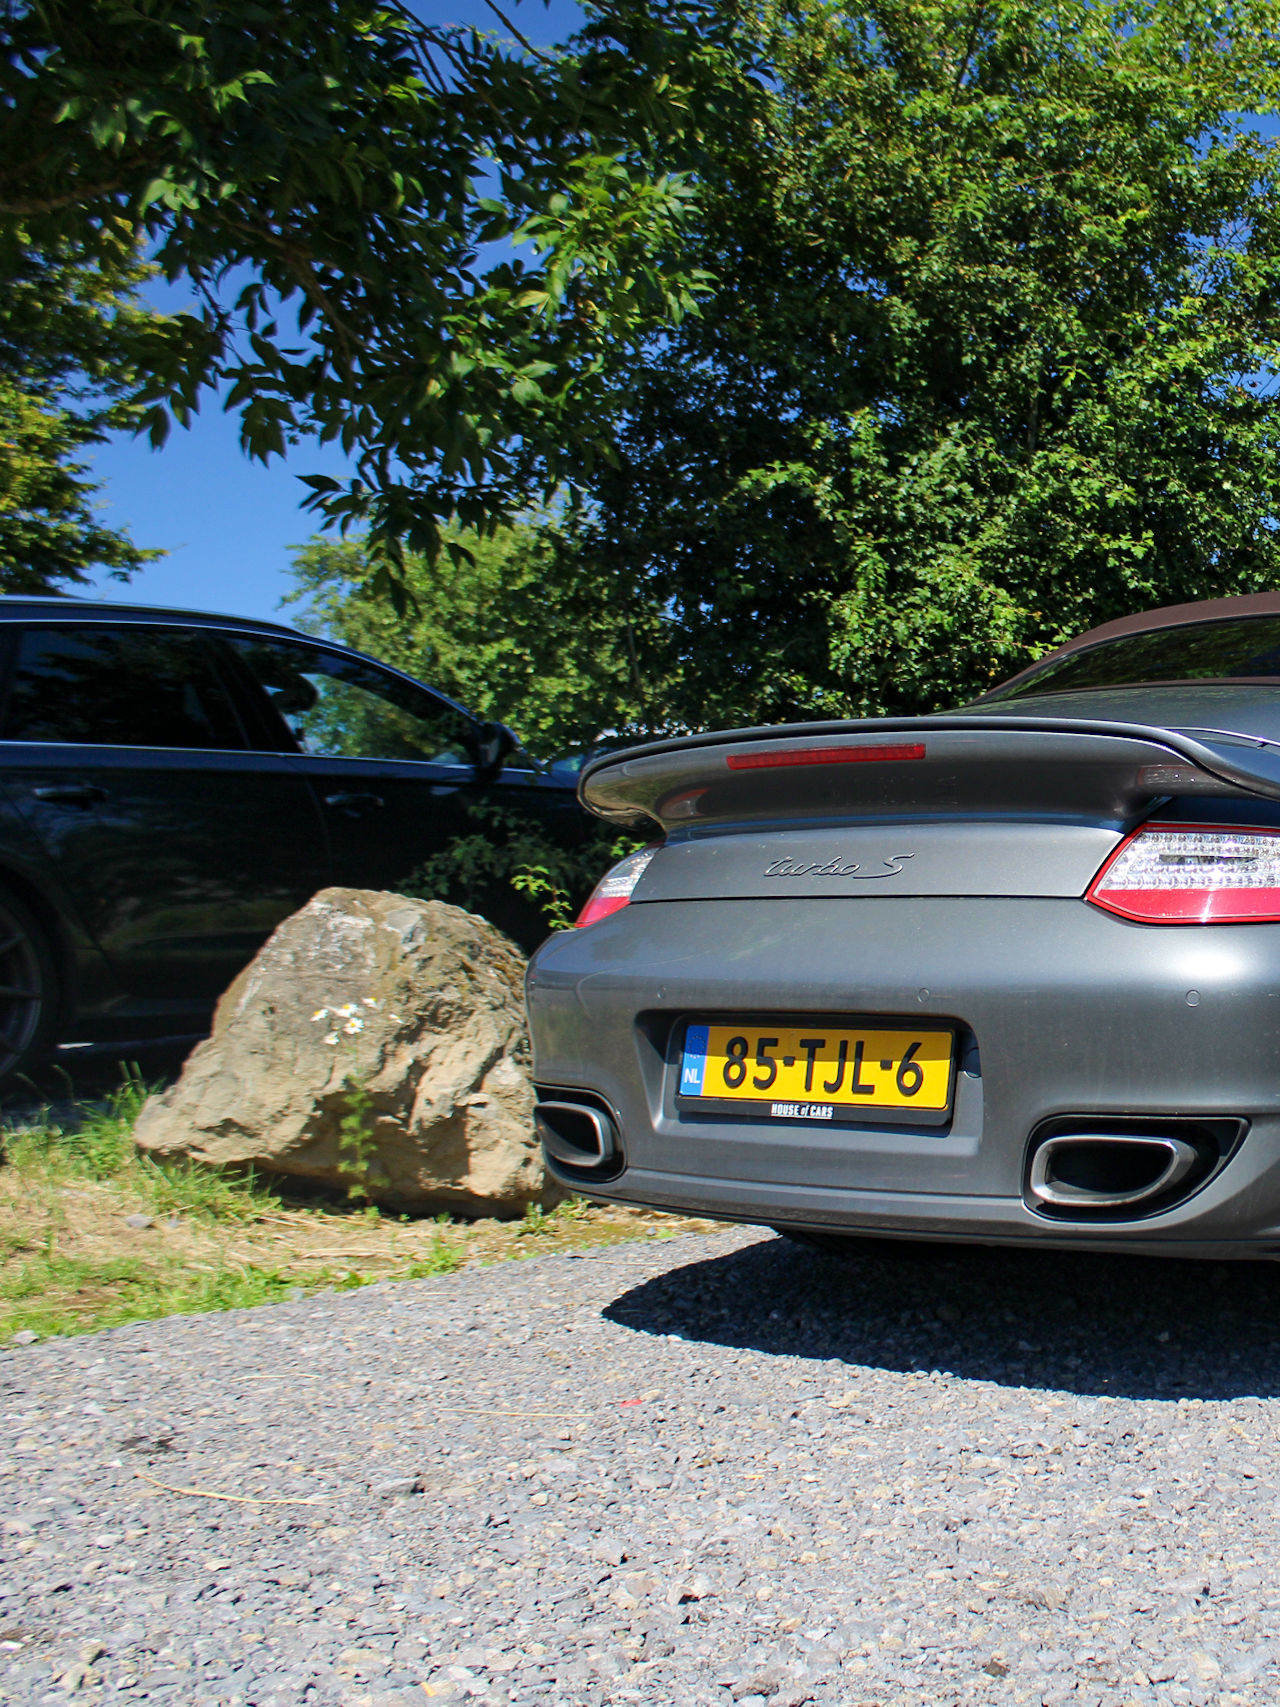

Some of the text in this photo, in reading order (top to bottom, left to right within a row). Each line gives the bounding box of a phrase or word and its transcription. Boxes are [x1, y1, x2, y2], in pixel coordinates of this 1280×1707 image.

[764, 852, 915, 879] turbo S
[684, 1068, 701, 1083] NL
[723, 1036, 923, 1096] 85-TJL-6
[771, 1102, 833, 1118] HOUSE of CARS
